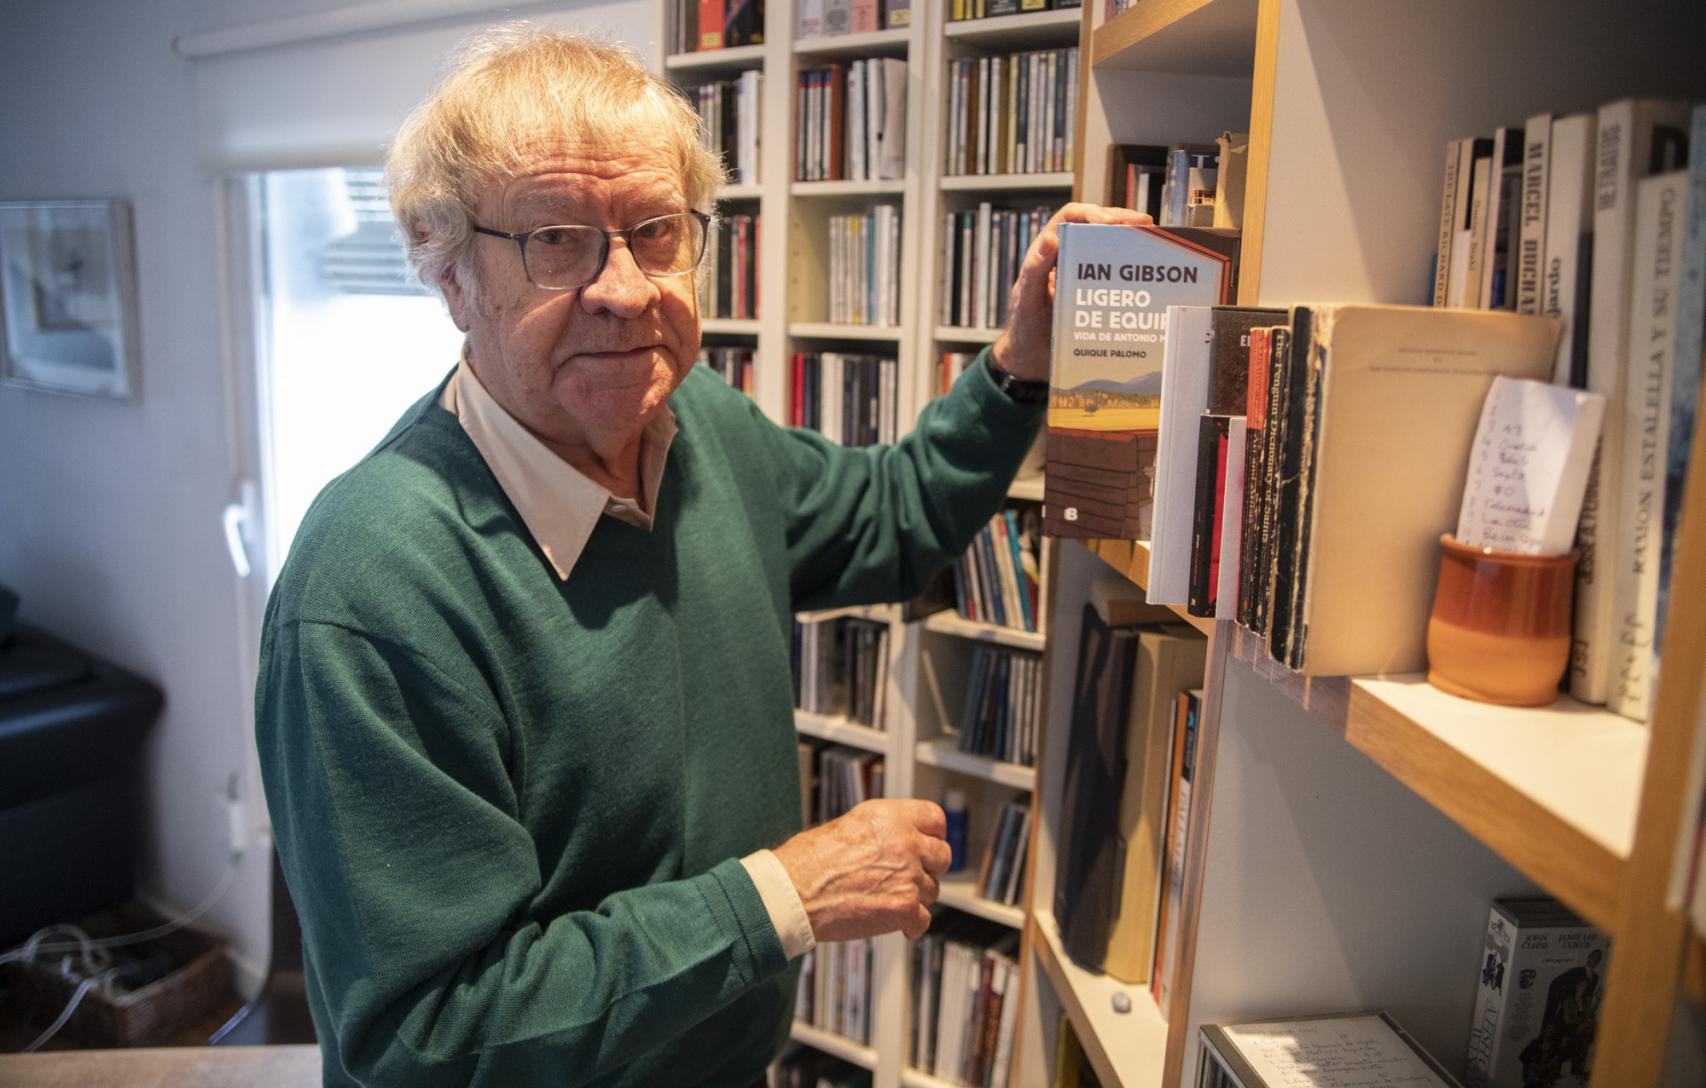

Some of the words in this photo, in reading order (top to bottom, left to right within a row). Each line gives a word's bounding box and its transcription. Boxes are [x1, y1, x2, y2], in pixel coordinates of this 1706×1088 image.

[1525, 142, 1543, 227] MARCEL
[1655, 187, 1677, 276] TIEMPO
[1438, 231, 1449, 291] RICHARD
[1077, 263, 1112, 281] IAN
[1119, 264, 1198, 283] GIBSON
[1075, 288, 1151, 308] LIGERO
[1653, 289, 1670, 320] SU
[1074, 310, 1103, 328] DE
[1109, 311, 1168, 330] EQUIP
[1073, 331, 1097, 341] VIDA
[1098, 332, 1112, 341] DE
[1113, 332, 1158, 343] ANTONIO
[1650, 327, 1667, 341] Y
[1073, 348, 1108, 358] QUIQUE
[1110, 349, 1147, 359] PALOMO
[1275, 333, 1285, 359] The
[1270, 363, 1283, 417] Penguin
[1264, 419, 1279, 487] Dictionary
[1265, 490, 1273, 502] of
[1063, 507, 1079, 522] B
[1261, 506, 1271, 544] Saints
